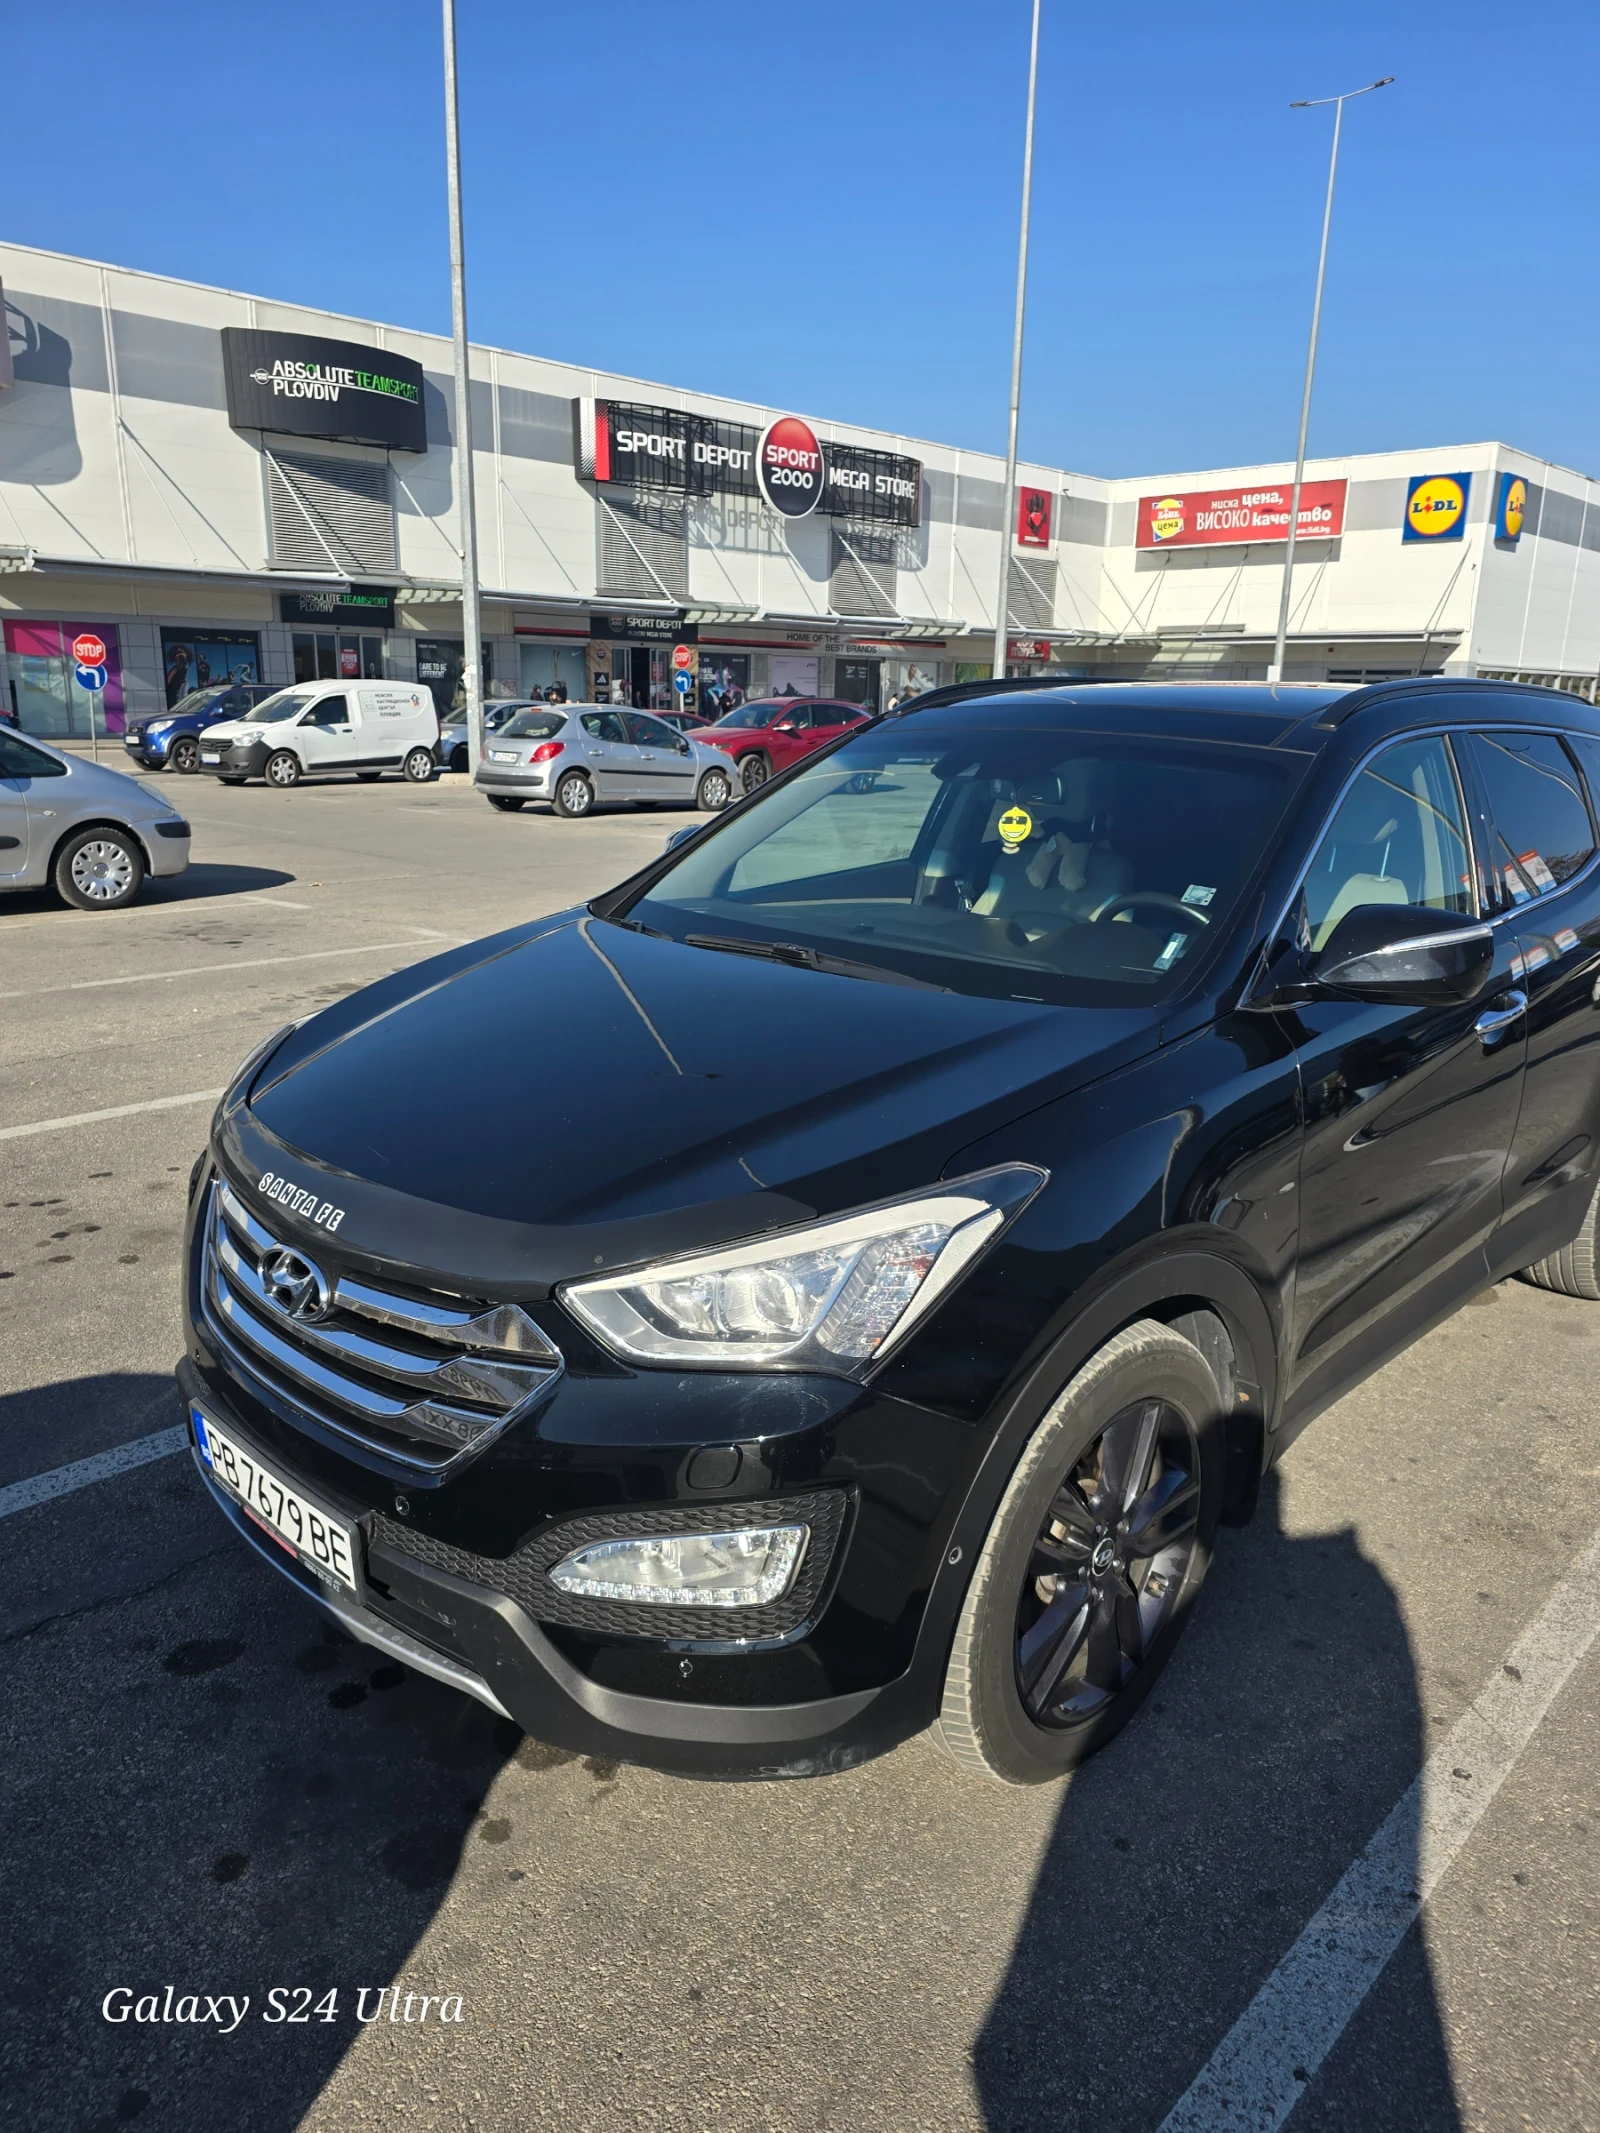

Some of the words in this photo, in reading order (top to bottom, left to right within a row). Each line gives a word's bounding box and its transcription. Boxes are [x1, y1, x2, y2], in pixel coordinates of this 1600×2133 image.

[272, 360, 355, 386] ABSOLUTE
[274, 379, 340, 402] PLOVDIV
[616, 430, 686, 460] SPORT
[694, 442, 752, 471] DEPOT
[766, 444, 819, 469] SPORT
[771, 467, 814, 489] 2000
[829, 467, 870, 491] MEGA
[875, 475, 915, 499] STORE
[1211, 499, 1239, 510] ниска
[1242, 491, 1284, 507] цена,
[1158, 521, 1179, 532] цена
[1196, 508, 1250, 530] ВИСОКО
[1252, 506, 1332, 526] качетво
[300, 602, 334, 613] PLOVDIV
[342, 594, 388, 606] TEAMSPORT
[627, 617, 655, 628] SPORT
[656, 619, 683, 630] DEPOT
[786, 632, 811, 641] HOME
[812, 634, 824, 642] OF
[825, 635, 840, 643] THE
[76, 643, 103, 658] STOP
[675, 652, 689, 662] STOP
[825, 644, 845, 652] BEST
[846, 645, 877, 653] BRANDS
[258, 1172, 318, 1217] SANTA
[314, 1202, 345, 1232] FE
